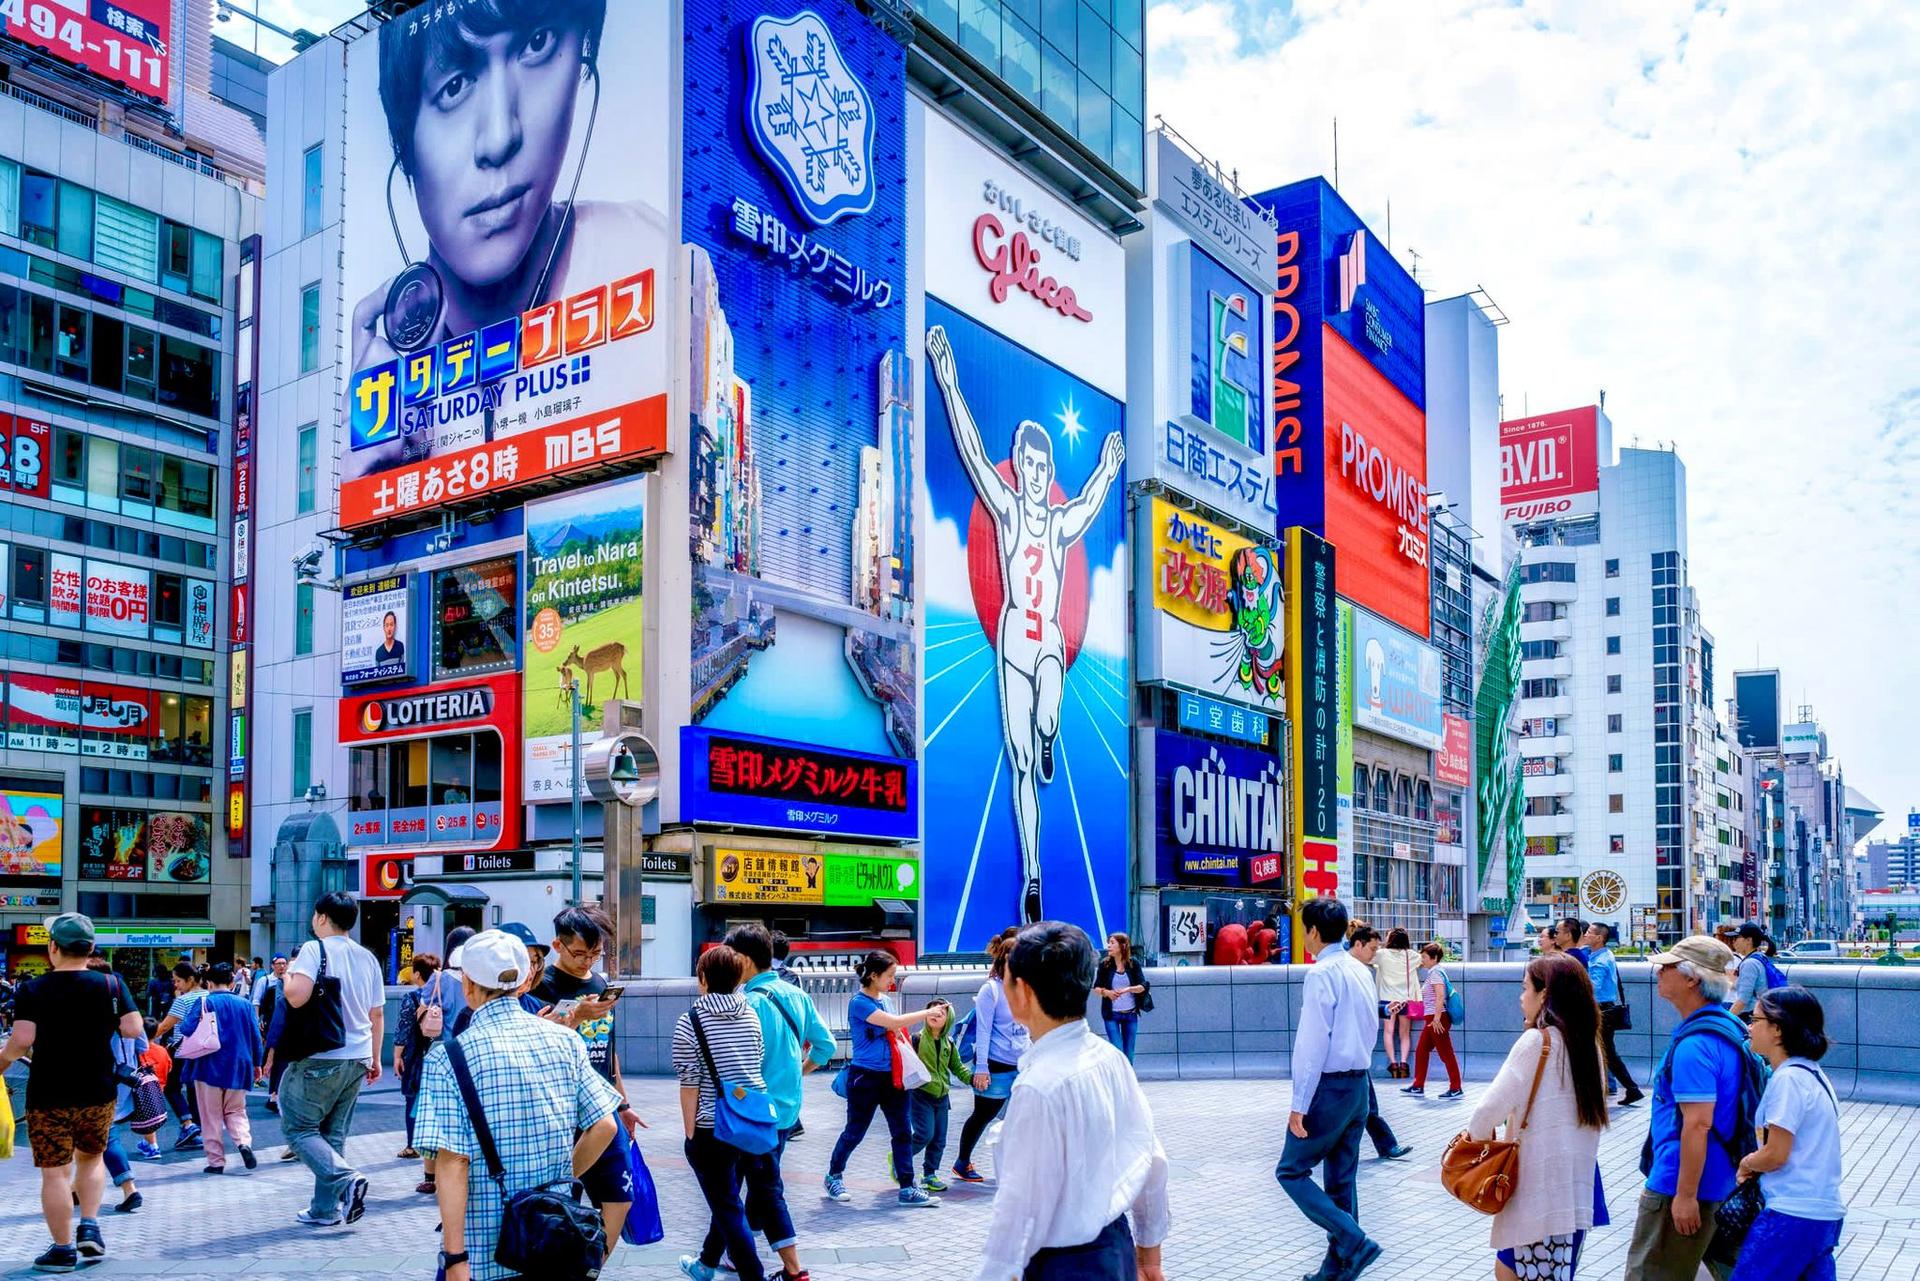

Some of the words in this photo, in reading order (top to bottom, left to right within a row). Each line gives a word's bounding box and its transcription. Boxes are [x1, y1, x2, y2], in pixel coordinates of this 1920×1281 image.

[106, 6, 145, 40] 検索
[1191, 167, 1252, 231] 夢ある住まい
[1181, 192, 1263, 271] エステムシリーズ
[732, 197, 892, 308] 雪印メグミルク
[973, 213, 1093, 323] Glico
[355, 278, 648, 438] サタデープラス
[403, 382, 508, 437] SATURDAY
[515, 362, 568, 402] PLUS
[30, 422, 49, 434] 5F
[372, 445, 519, 516] 土曜あさ8時
[545, 417, 622, 470] MBS
[1342, 421, 1428, 535] PROMISE
[1504, 499, 1572, 521] FUJIBO
[1168, 512, 1223, 560] かぜに
[532, 548, 581, 577] Travel
[584, 553, 595, 567] to
[598, 540, 638, 563] Nara
[52, 568, 148, 600] 女性のお客様
[52, 585, 110, 609] 飲み放題
[532, 590, 546, 604] on
[548, 573, 623, 601] Kintetsu.
[1024, 542, 1045, 642] グリコ
[1161, 547, 1229, 615] 改源
[110, 597, 148, 625] 0円
[539, 623, 554, 640] 35
[387, 690, 485, 726] LOTTERIA
[1185, 699, 1265, 738] 戸堂歯科
[10, 737, 24, 747] AM
[710, 745, 907, 807] 雪印メグミルク牛乳
[787, 808, 839, 824] 雪印メグミルク
[1173, 745, 1284, 852] CHINTAI
[393, 818, 426, 834] 完全分煙
[127, 867, 143, 878] 2F
[477, 854, 512, 869] Toilets
[642, 856, 677, 870] Toilets
[126, 934, 173, 944] FamilyMart
